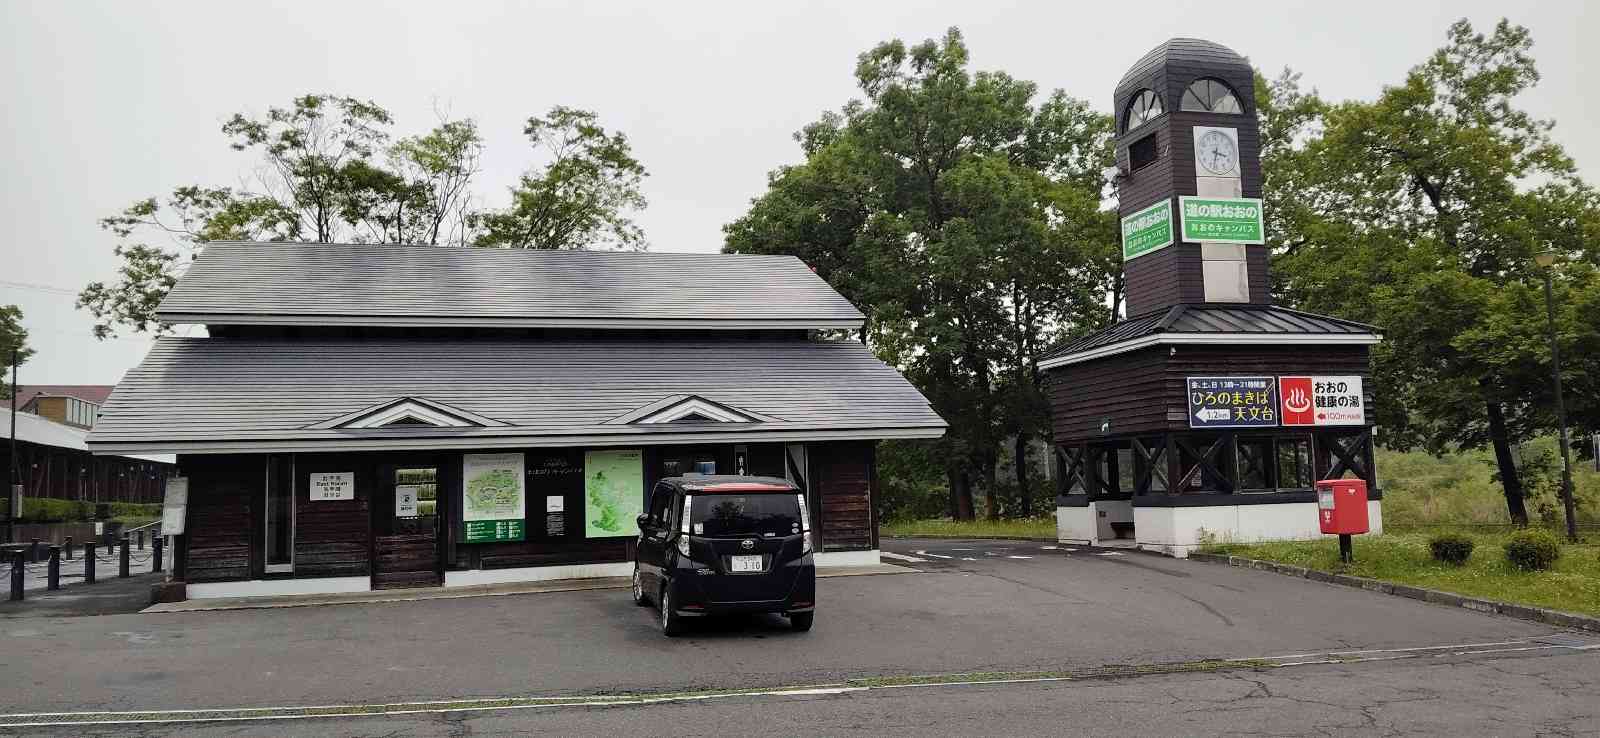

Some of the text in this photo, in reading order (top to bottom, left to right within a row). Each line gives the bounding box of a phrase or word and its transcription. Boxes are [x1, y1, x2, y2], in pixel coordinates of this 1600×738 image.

[1185, 203, 1257, 219] 道の駅おおの
[1315, 382, 1347, 393] おおの
[1315, 396, 1360, 408] 健康の湯
[1233, 406, 1274, 421] 天文台
